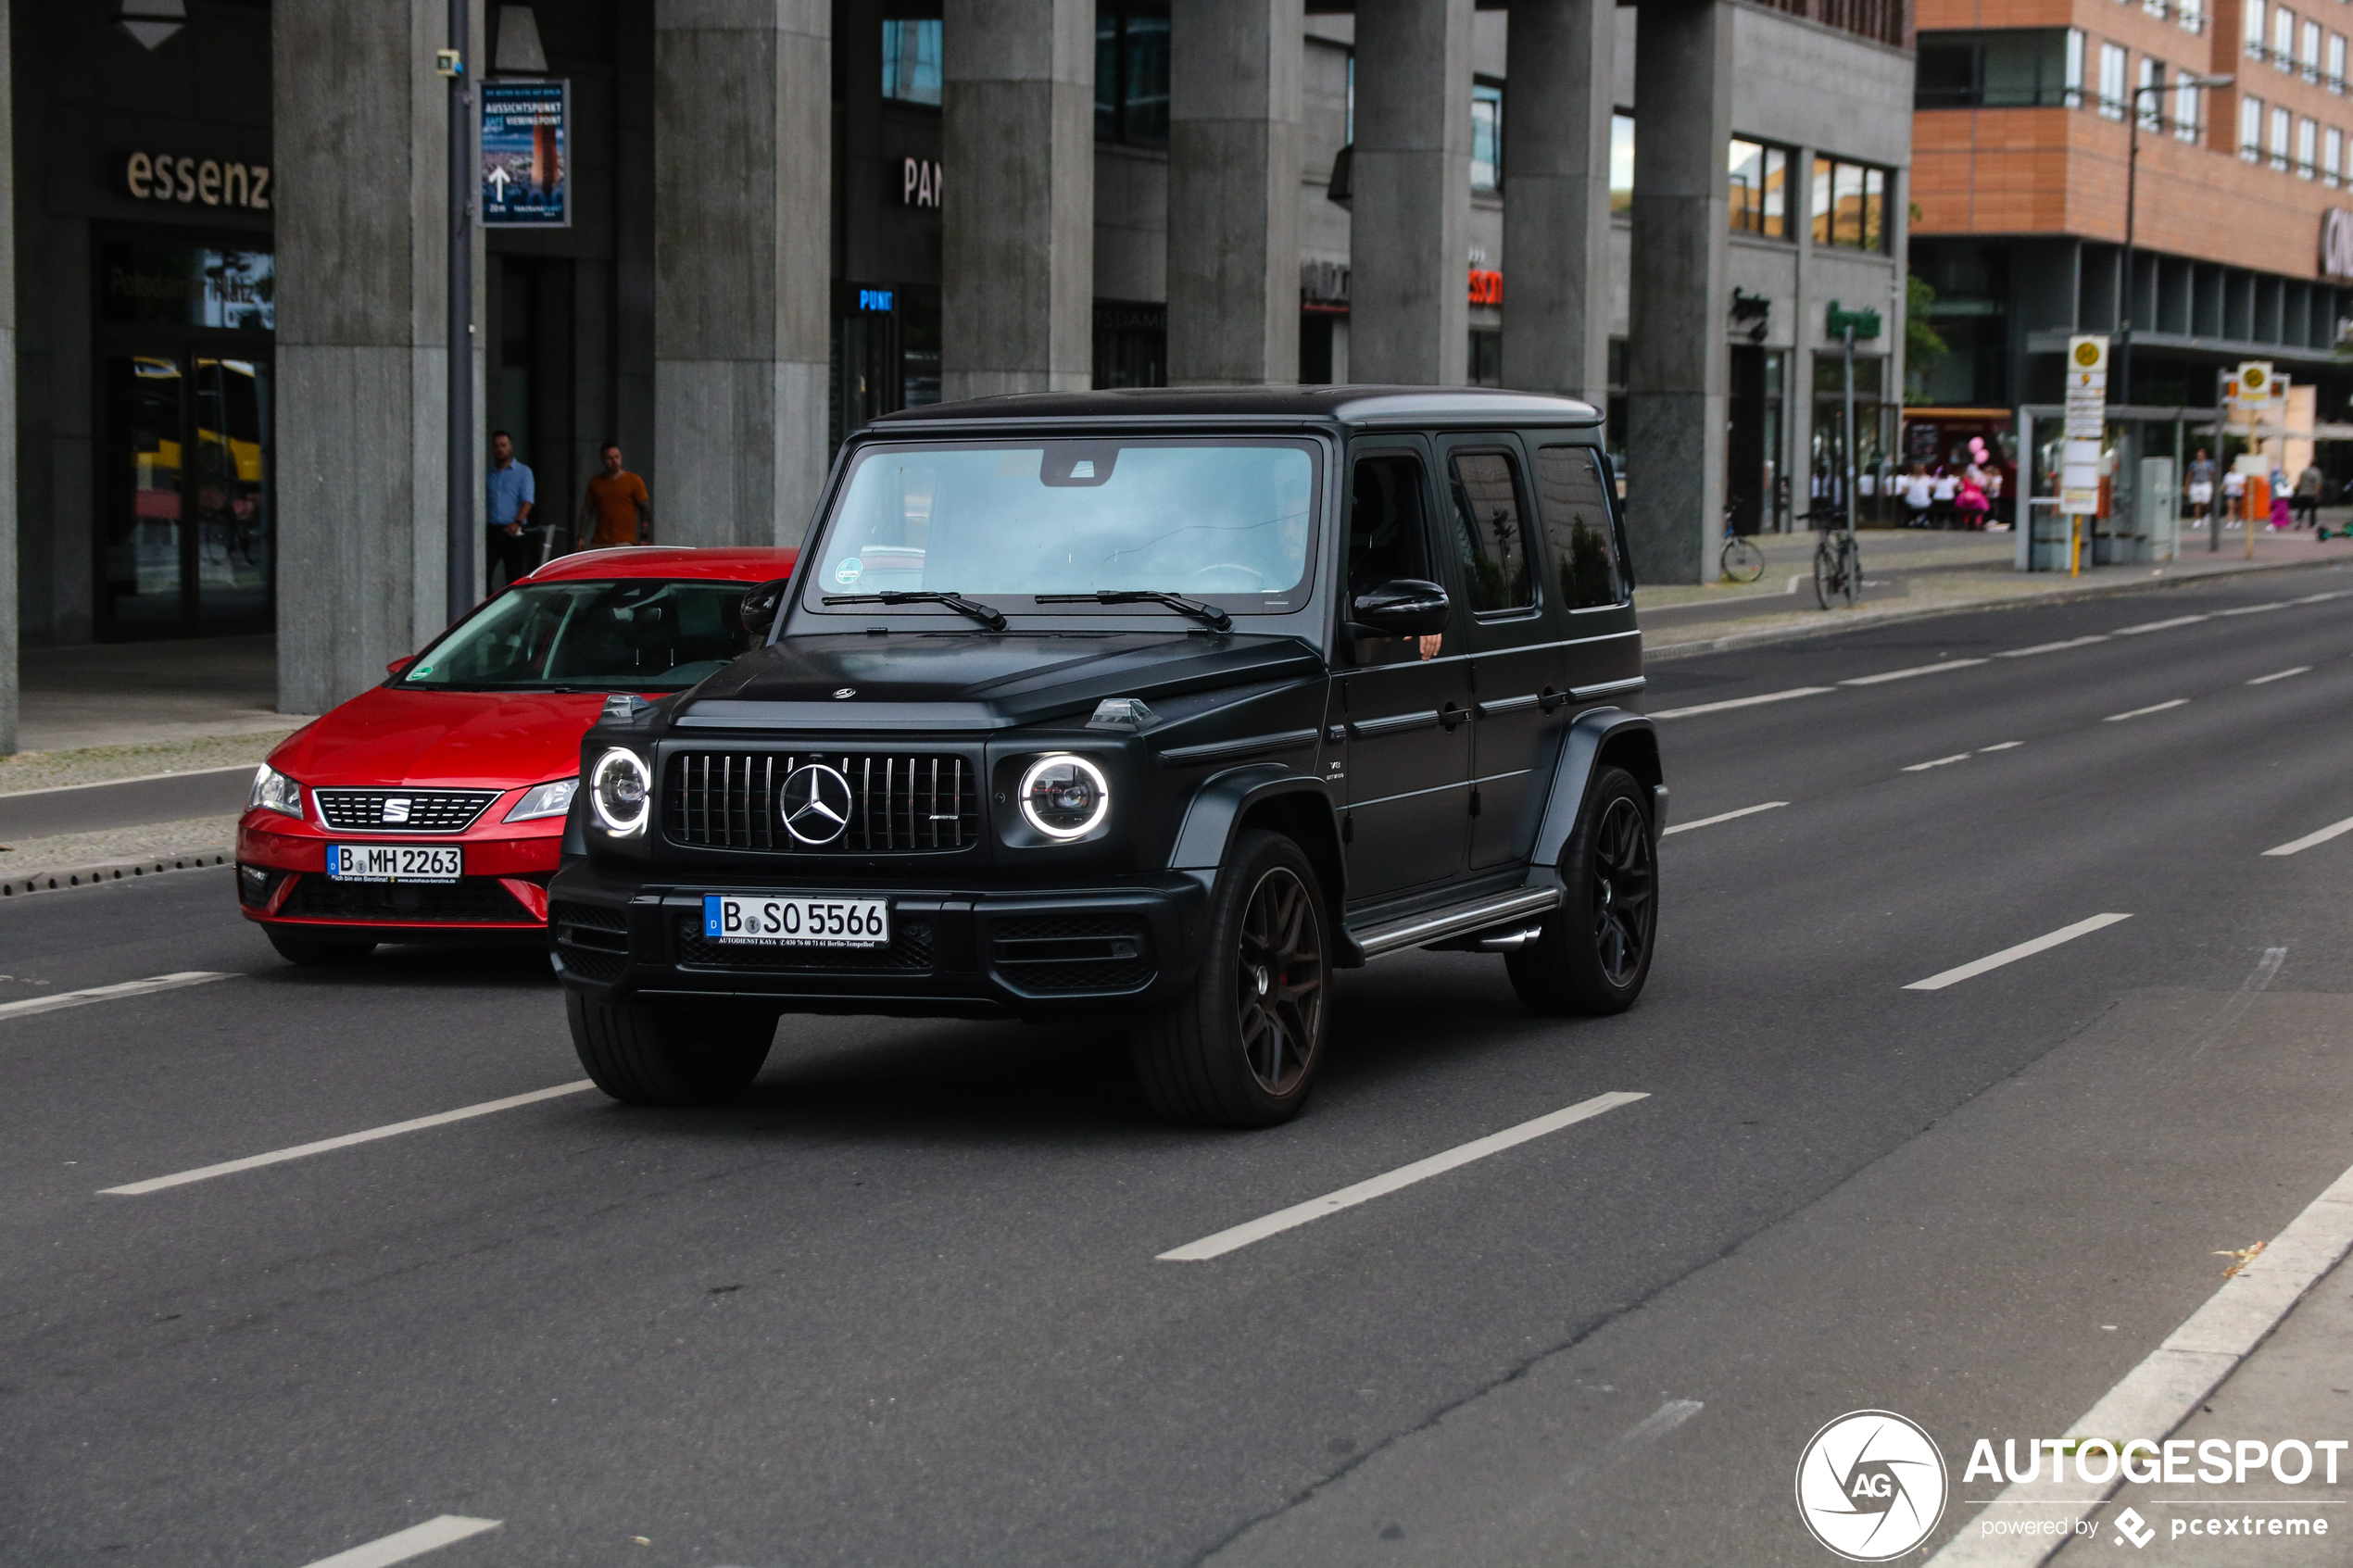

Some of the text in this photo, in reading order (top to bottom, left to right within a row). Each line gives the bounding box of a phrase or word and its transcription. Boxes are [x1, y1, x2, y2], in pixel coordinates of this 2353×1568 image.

[485, 102, 561, 114] AUSSICHTSPUNKT
[128, 151, 273, 209] essenz
[340, 848, 458, 873] B MH 2263
[711, 920, 717, 929] D
[724, 901, 882, 935] B SO 5566
